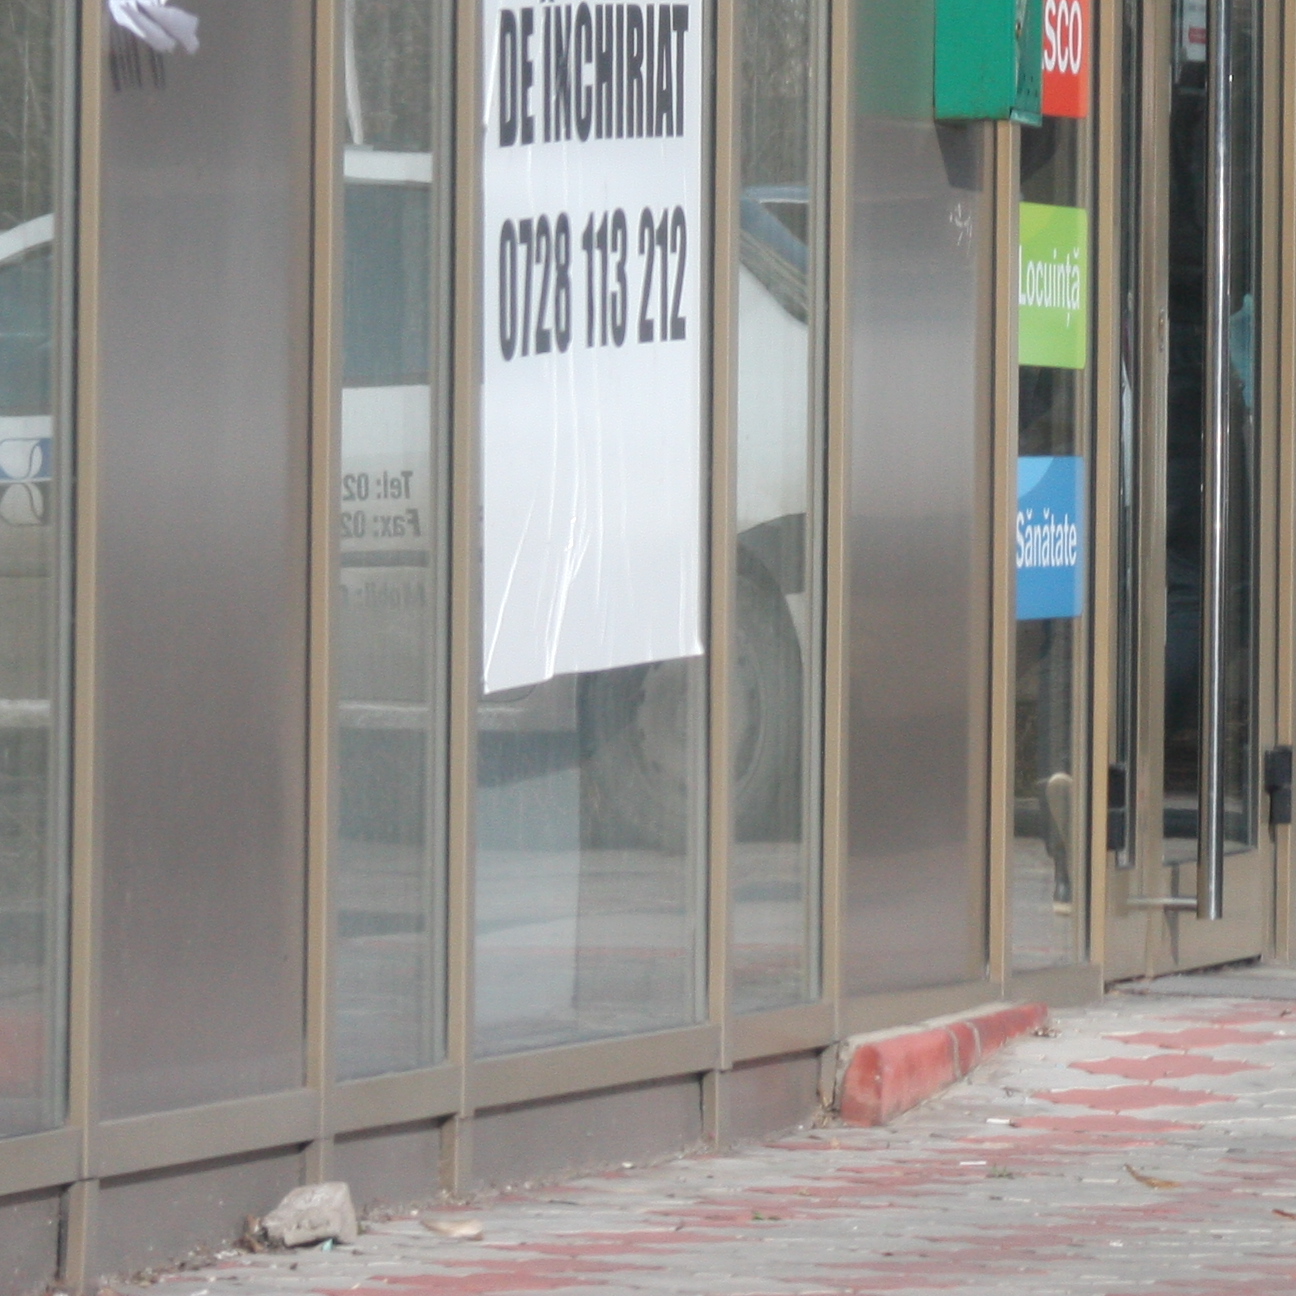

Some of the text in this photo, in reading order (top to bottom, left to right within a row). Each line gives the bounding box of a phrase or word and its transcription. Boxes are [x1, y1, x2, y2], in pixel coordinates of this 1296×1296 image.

[499, 6, 534, 148] DE
[499, 204, 688, 362] 0728 113 212
[1016, 508, 1078, 570] Sănătate
